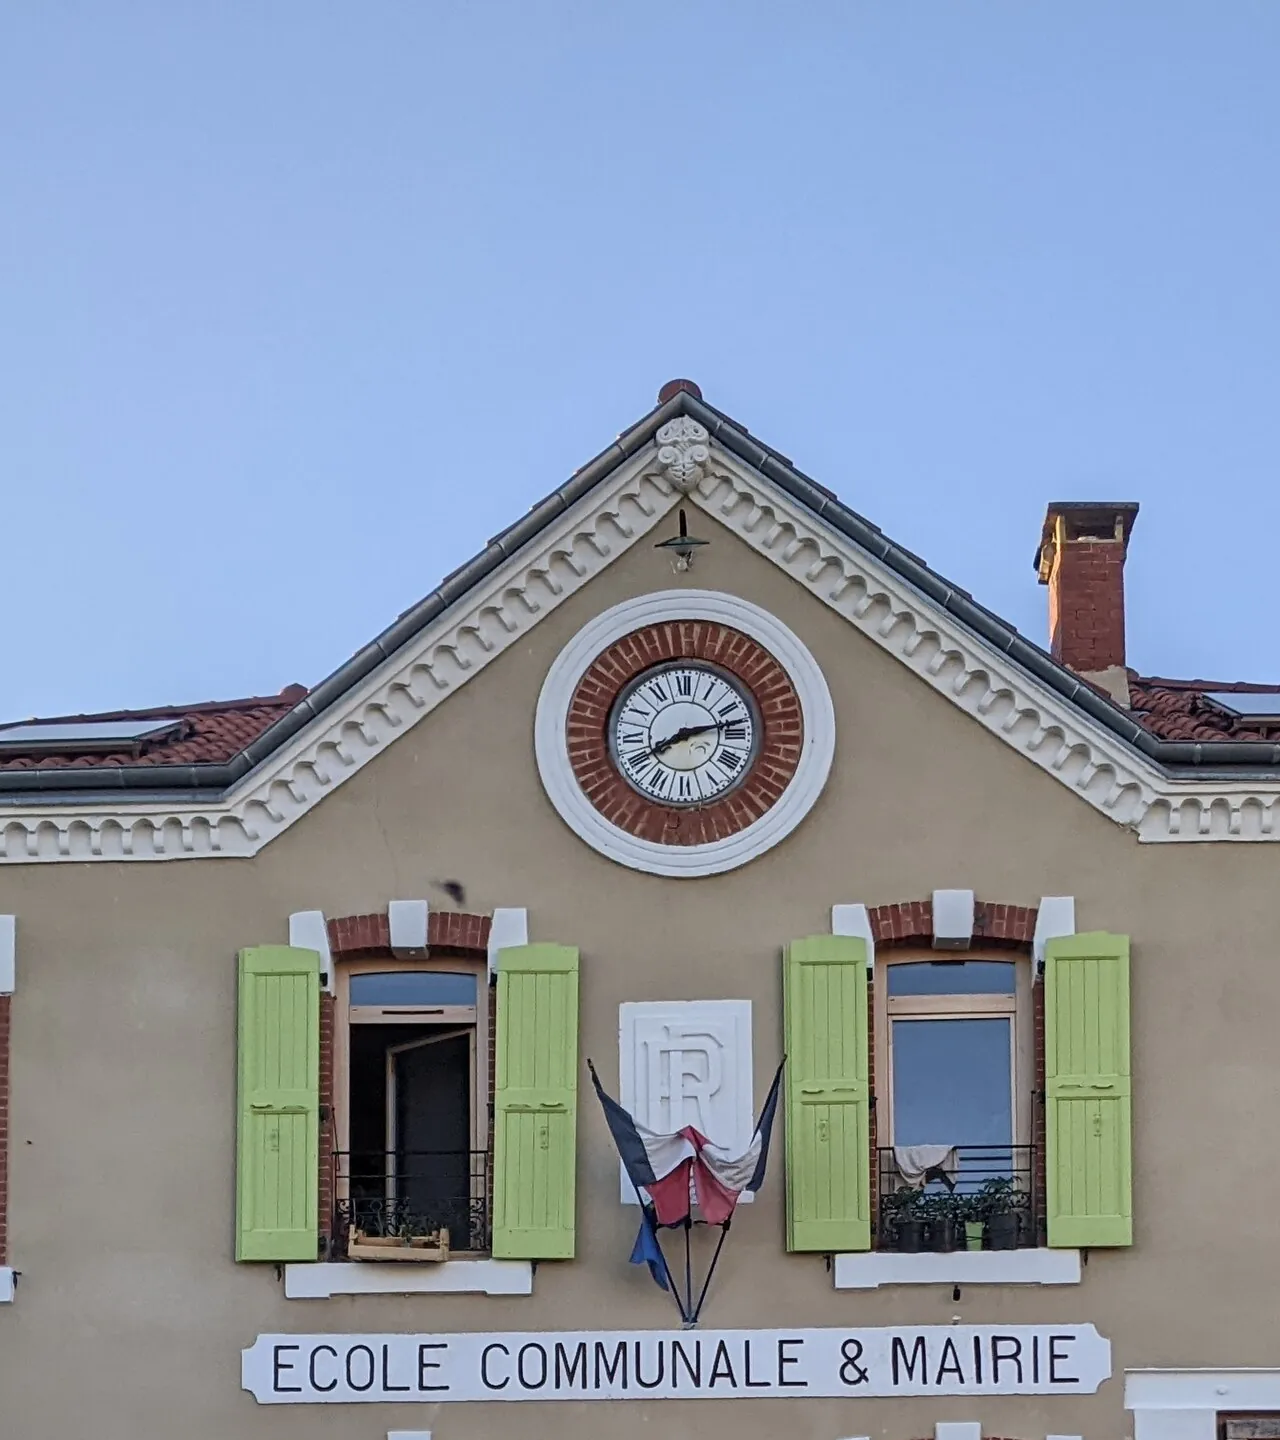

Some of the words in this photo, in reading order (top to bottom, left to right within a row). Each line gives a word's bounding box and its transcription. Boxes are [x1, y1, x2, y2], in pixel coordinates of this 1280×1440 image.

[648, 681, 669, 703] XI
[675, 675, 692, 697] XII
[703, 682, 716, 701] I
[628, 702, 651, 721] X
[717, 701, 739, 718] II
[622, 731, 644, 744] IX
[724, 728, 746, 741] III
[648, 767, 671, 792] VII
[679, 775, 692, 797] VI
[705, 769, 721, 788] V
[273, 1344, 450, 1393] ECOLE
[481, 1339, 808, 1390] COMMUNALE
[839, 1338, 870, 1386] &
[891, 1333, 1080, 1386] MAIRIE
